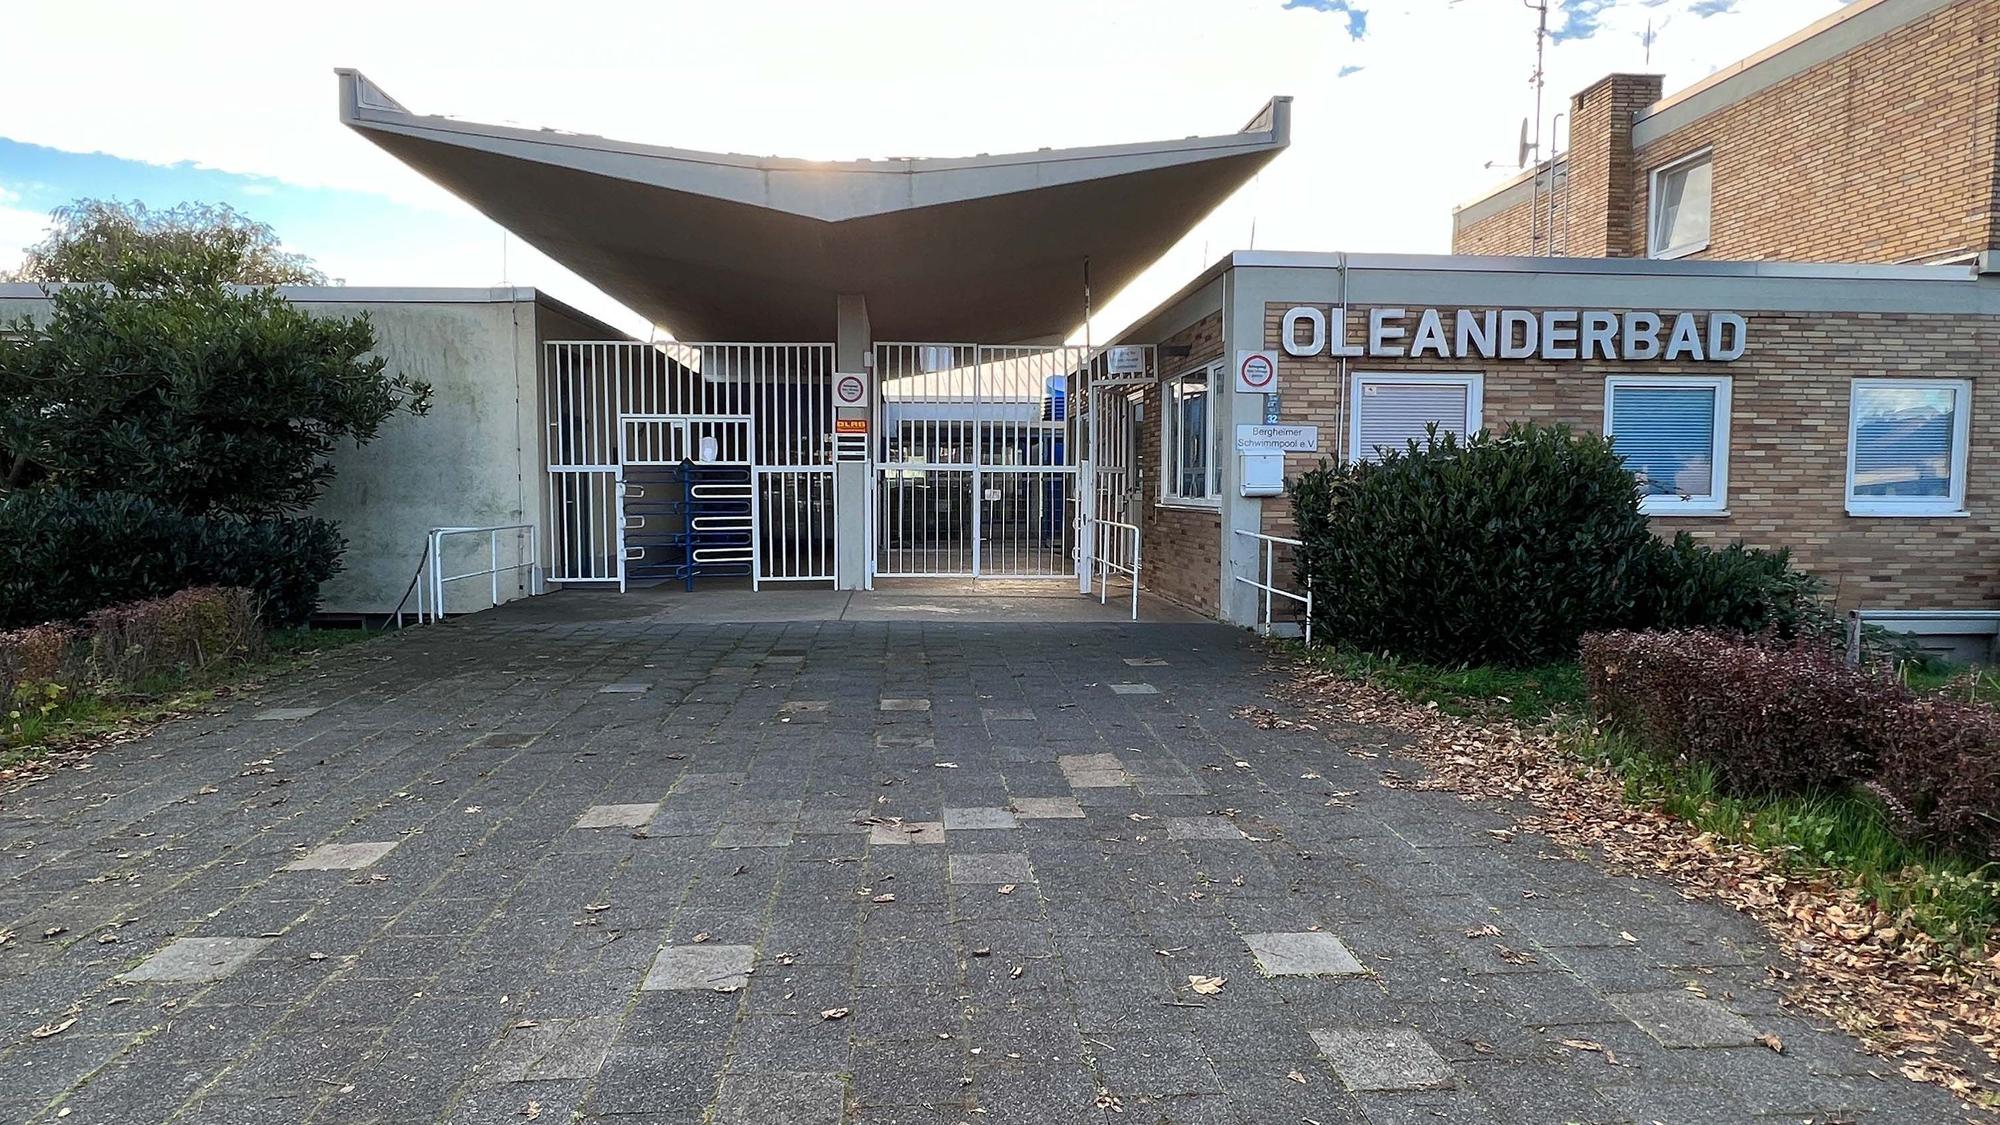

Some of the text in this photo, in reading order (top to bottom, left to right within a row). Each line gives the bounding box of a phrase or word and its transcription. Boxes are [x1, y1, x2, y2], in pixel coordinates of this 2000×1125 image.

[1281, 306, 1747, 361] OLEANDERBAD
[1267, 414, 1278, 424] 32
[1252, 427, 1302, 437] Bergheimer
[1238, 438, 1298, 448] Schwimmpool
